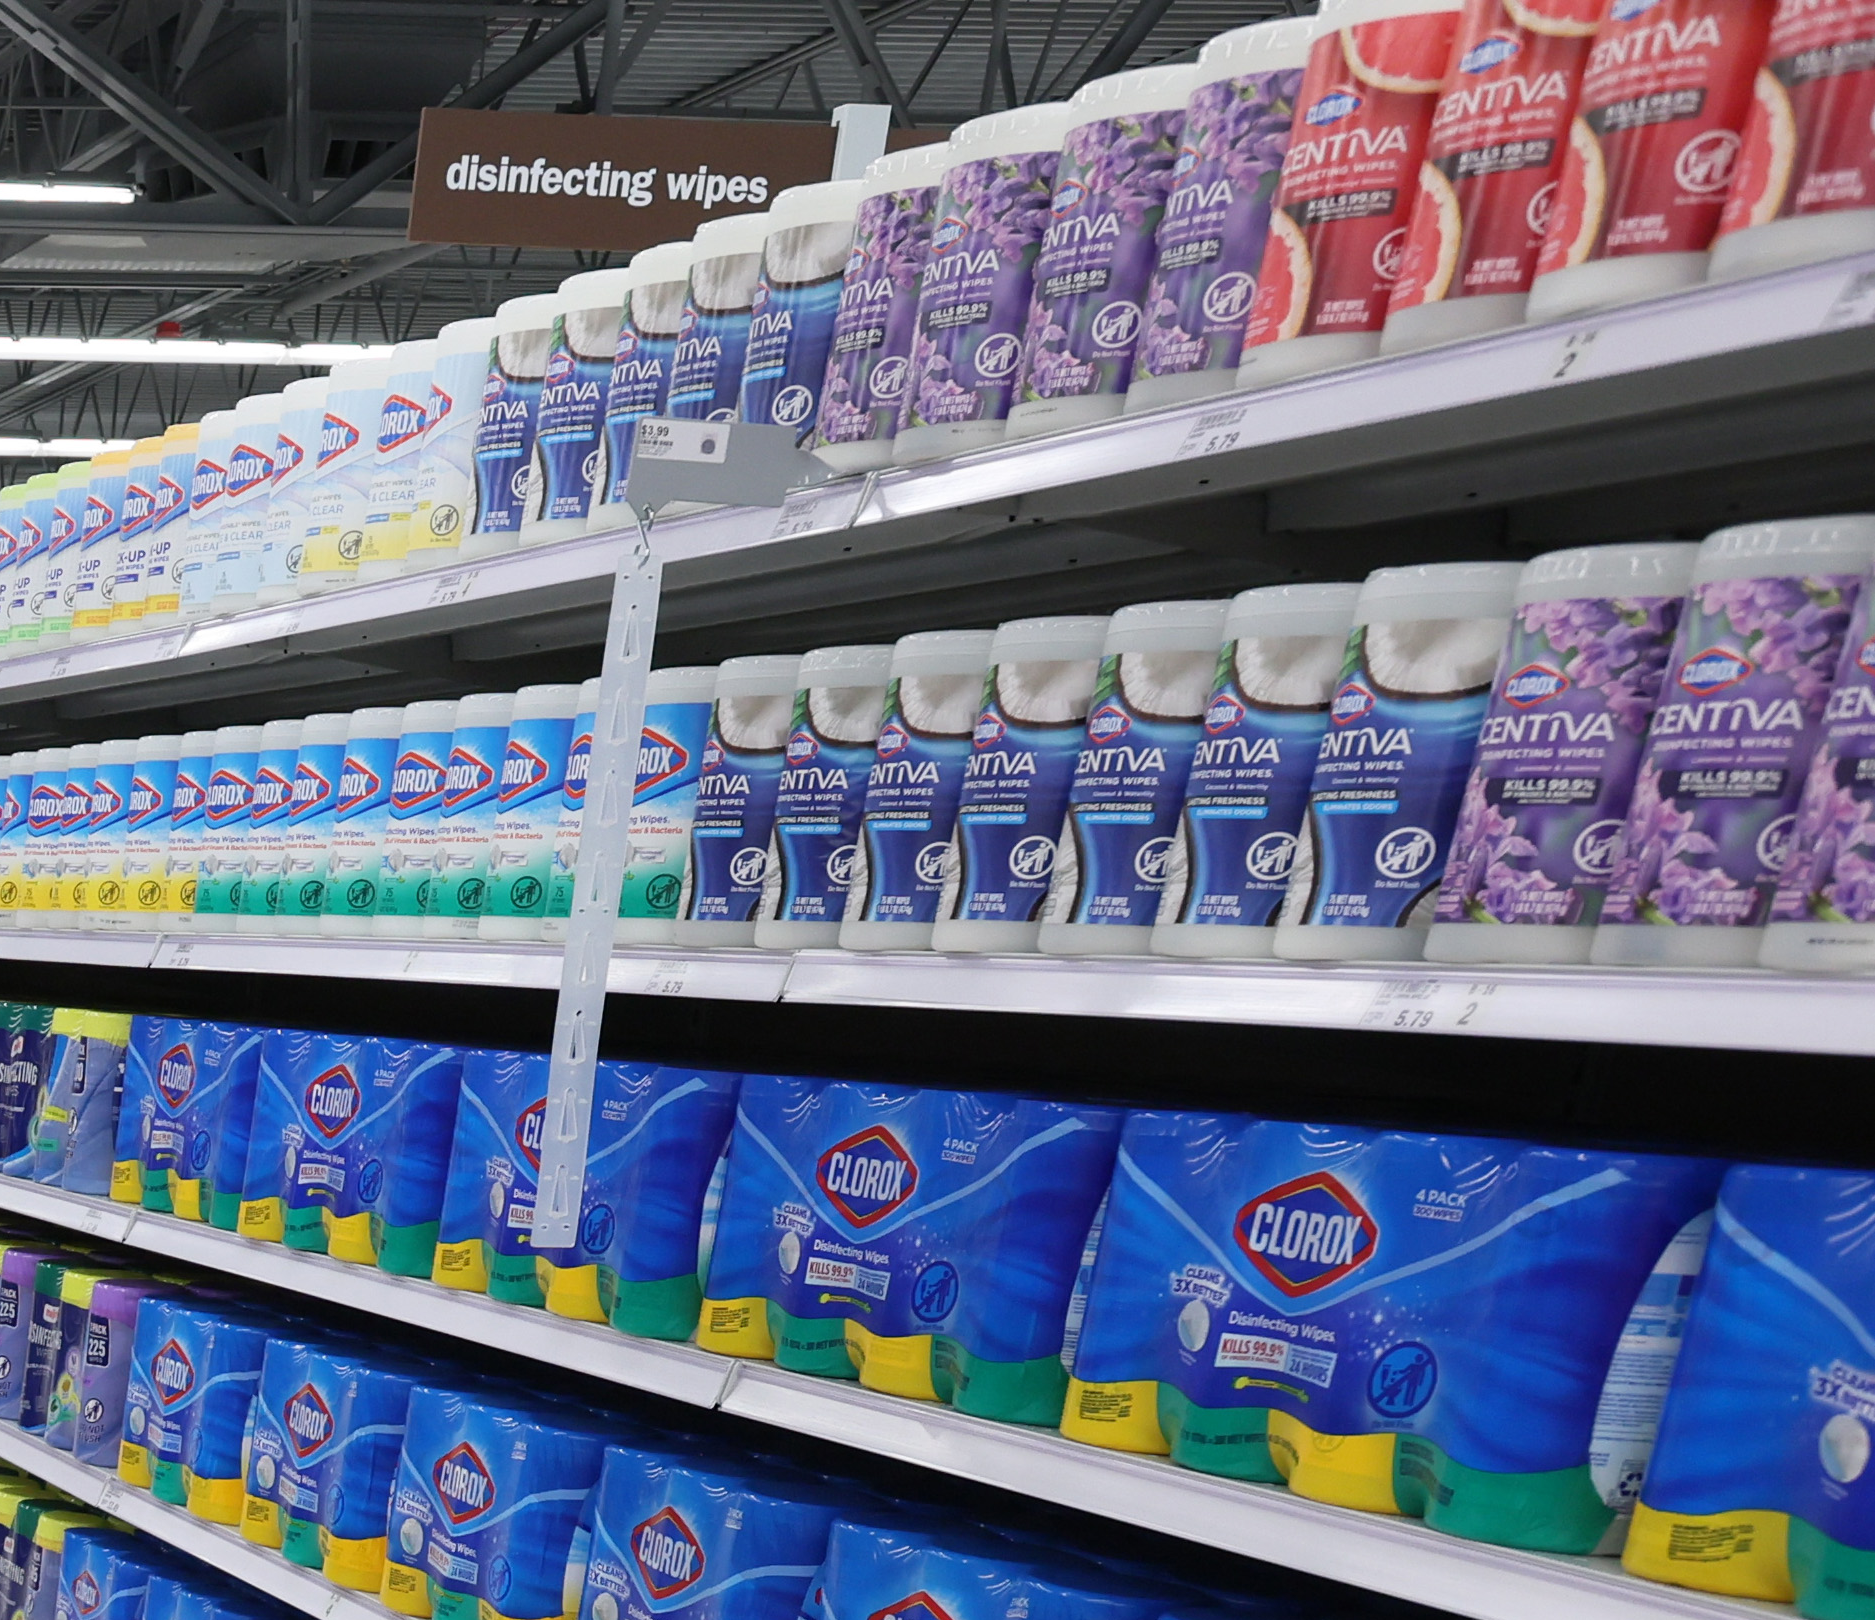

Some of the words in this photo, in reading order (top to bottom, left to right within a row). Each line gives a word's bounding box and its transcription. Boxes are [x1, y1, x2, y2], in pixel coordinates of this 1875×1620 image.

[1283, 126, 1408, 174] CENTIVA
[445, 154, 656, 207] disinfecting
[667, 165, 768, 209] wipes
[1555, 352, 1576, 377] 2
[1205, 432, 1241, 451] 5.79
[1680, 659, 1751, 686] CLOROX
[1652, 698, 1803, 734] CENTIVA
[1679, 770, 1727, 786] KILLS
[1394, 1008, 1434, 1029] 5.79
[1456, 1001, 1478, 1025] 2
[310, 1083, 355, 1118] CLOROX
[953, 1139, 981, 1155] PACK
[827, 1152, 908, 1200] CLOROX
[1427, 1190, 1467, 1208] PACK
[1249, 1202, 1362, 1265] CLOROX
[813, 1238, 861, 1261] Disinfecting
[864, 1247, 890, 1265] Wipes
[808, 1259, 830, 1276] KILLS
[1174, 1279, 1192, 1294] 3X
[1228, 1311, 1298, 1337] Disinfecting
[1301, 1323, 1335, 1343] Wipes
[88, 1339, 105, 1356] 225
[1221, 1338, 1250, 1356] KILLS
[1253, 1341, 1284, 1357] 99.9%
